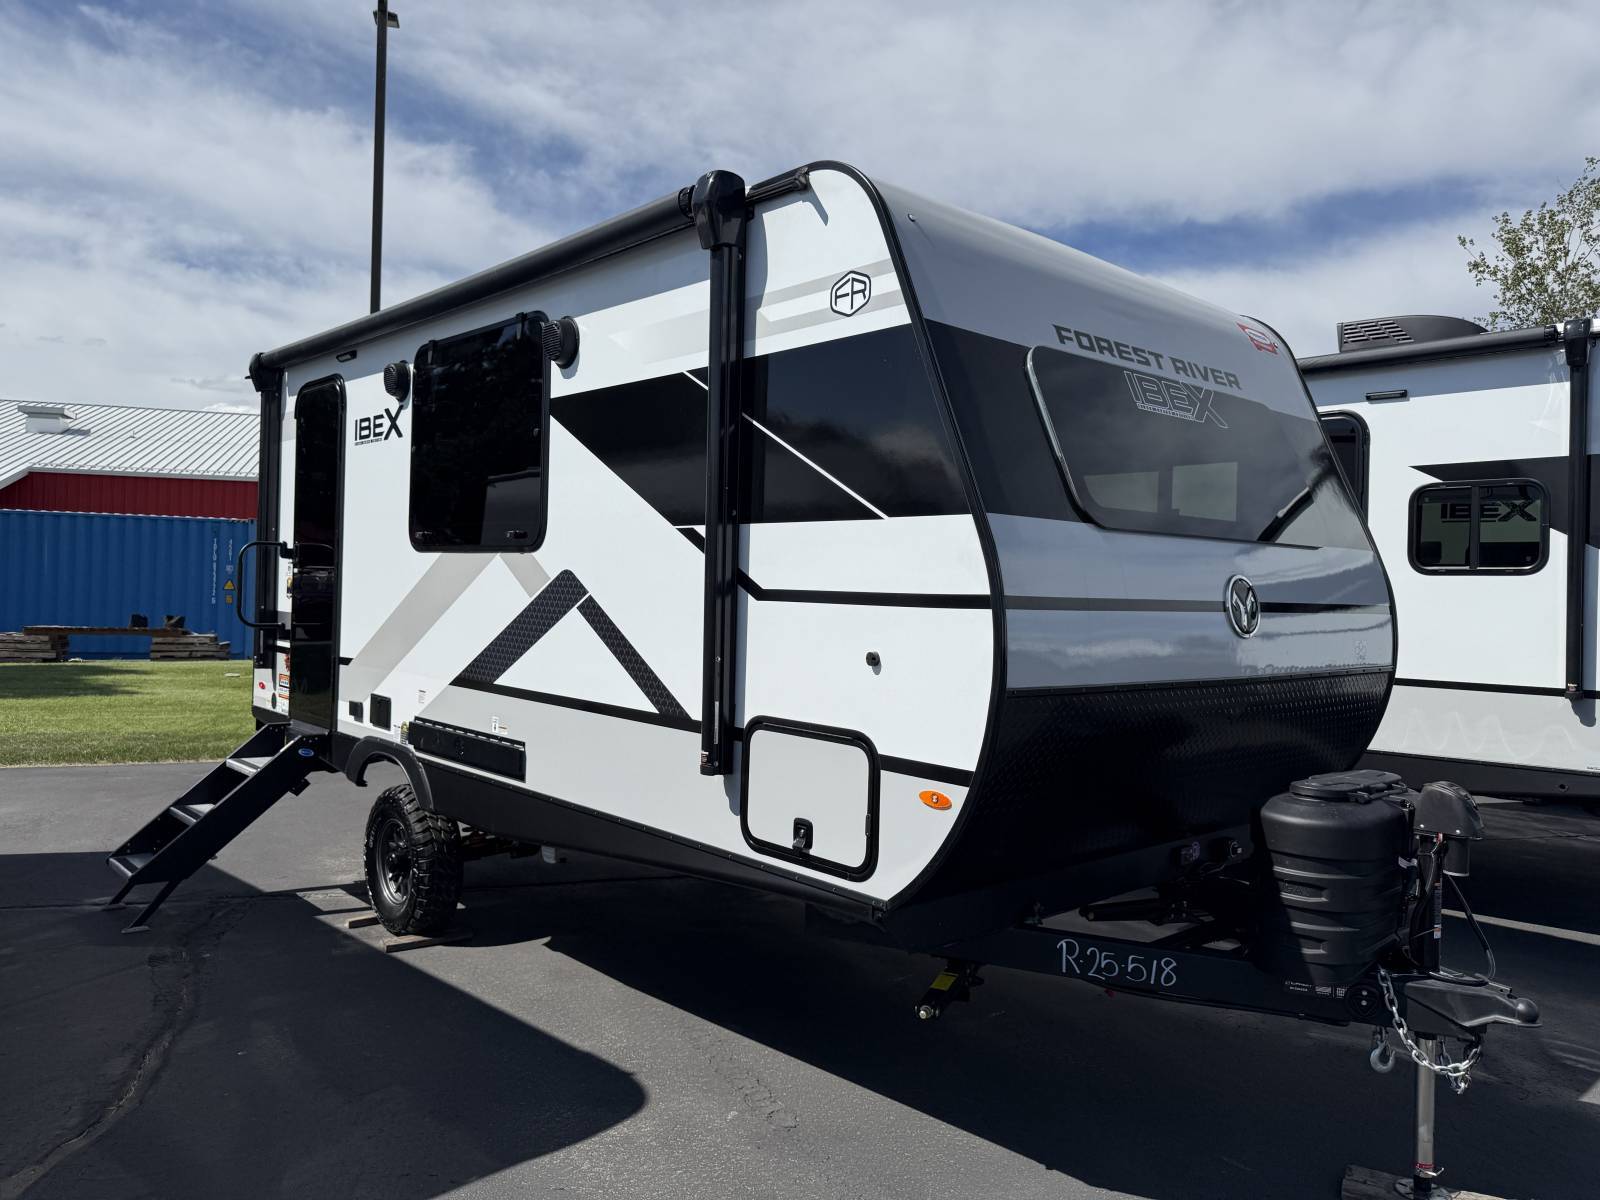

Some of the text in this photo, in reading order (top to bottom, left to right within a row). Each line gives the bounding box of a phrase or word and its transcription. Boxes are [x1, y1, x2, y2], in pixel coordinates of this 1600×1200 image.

[1053, 323, 1242, 390] FOREST RIVER
[354, 404, 404, 441] IBEX
[1123, 370, 1229, 429] IBEX
